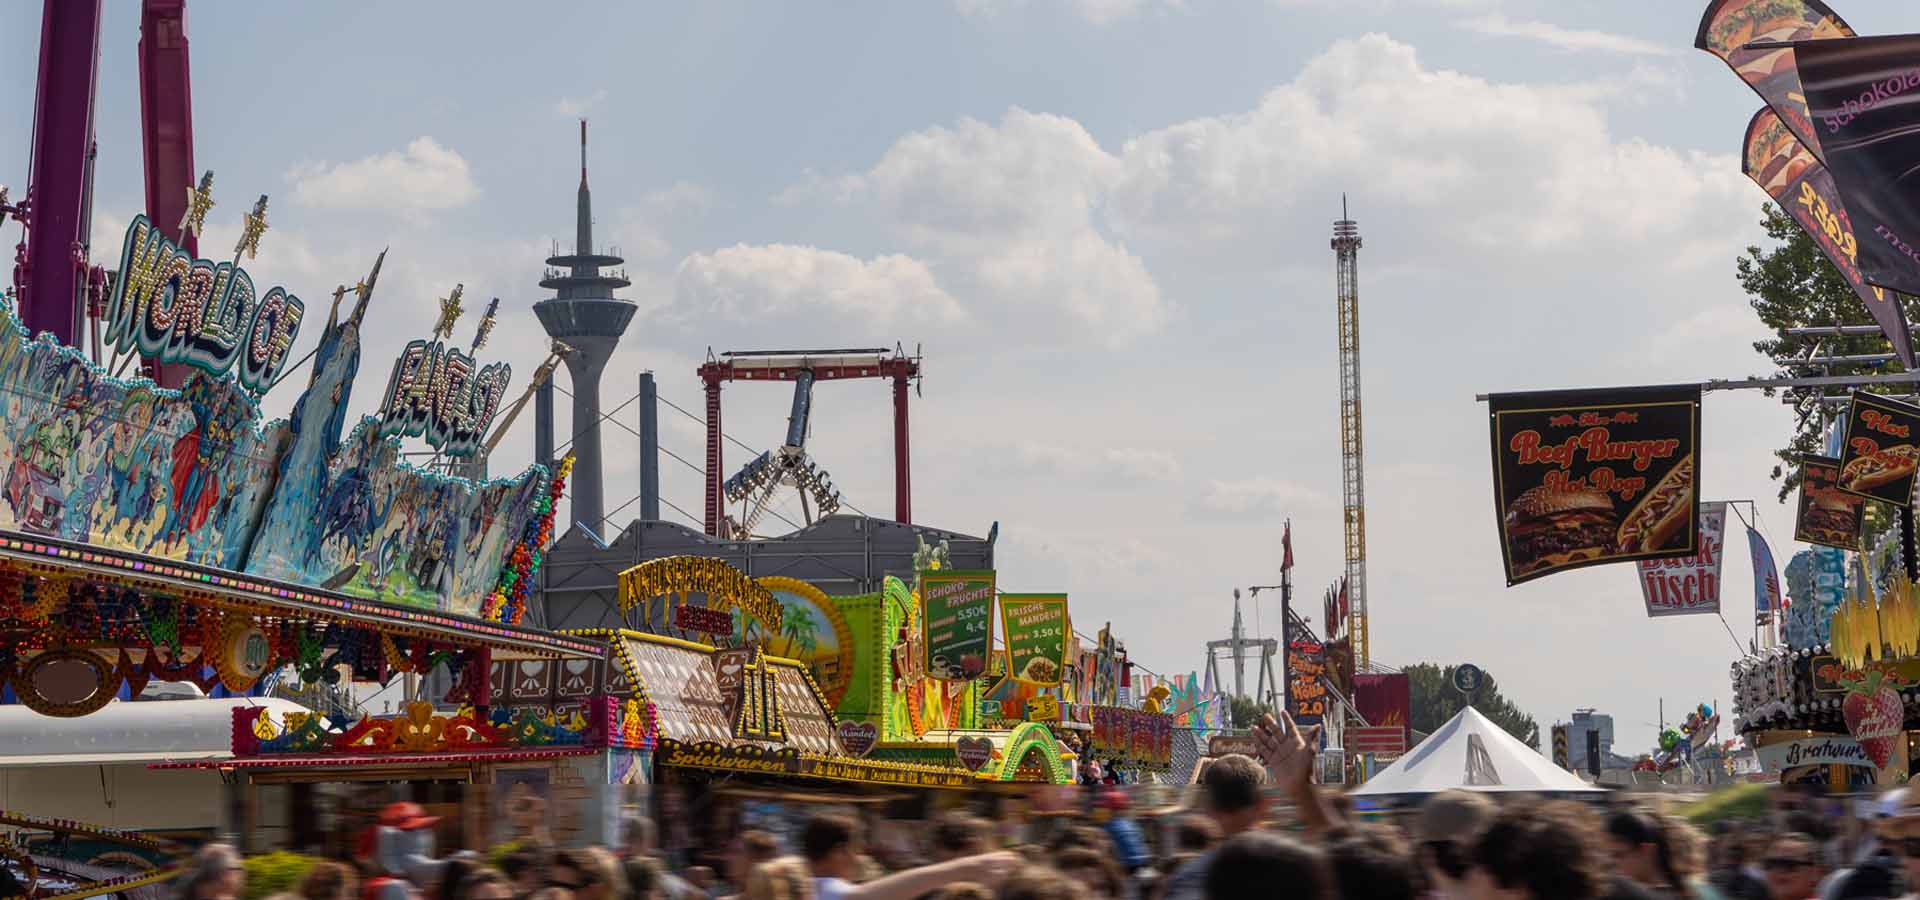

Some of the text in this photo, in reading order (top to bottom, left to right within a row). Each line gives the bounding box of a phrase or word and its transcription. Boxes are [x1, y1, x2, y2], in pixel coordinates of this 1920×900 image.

[111, 217, 303, 382] WORLD OF
[387, 342, 511, 446] FANTASY
[1860, 409, 1910, 438] Hot
[1510, 427, 1680, 471] Beef Burger
[1850, 436, 1914, 469] Dogs
[1543, 467, 1646, 501] Hot Dogs
[927, 582, 969, 600] SCHOKO-
[1644, 568, 1715, 607] fisch
[1008, 603, 1045, 617] FRISCHE
[1018, 608, 1061, 626] MANDELN
[1299, 701, 1324, 715] 2.0
[668, 750, 785, 771] Spielwaren
[1786, 740, 1870, 765] Bratwurs
